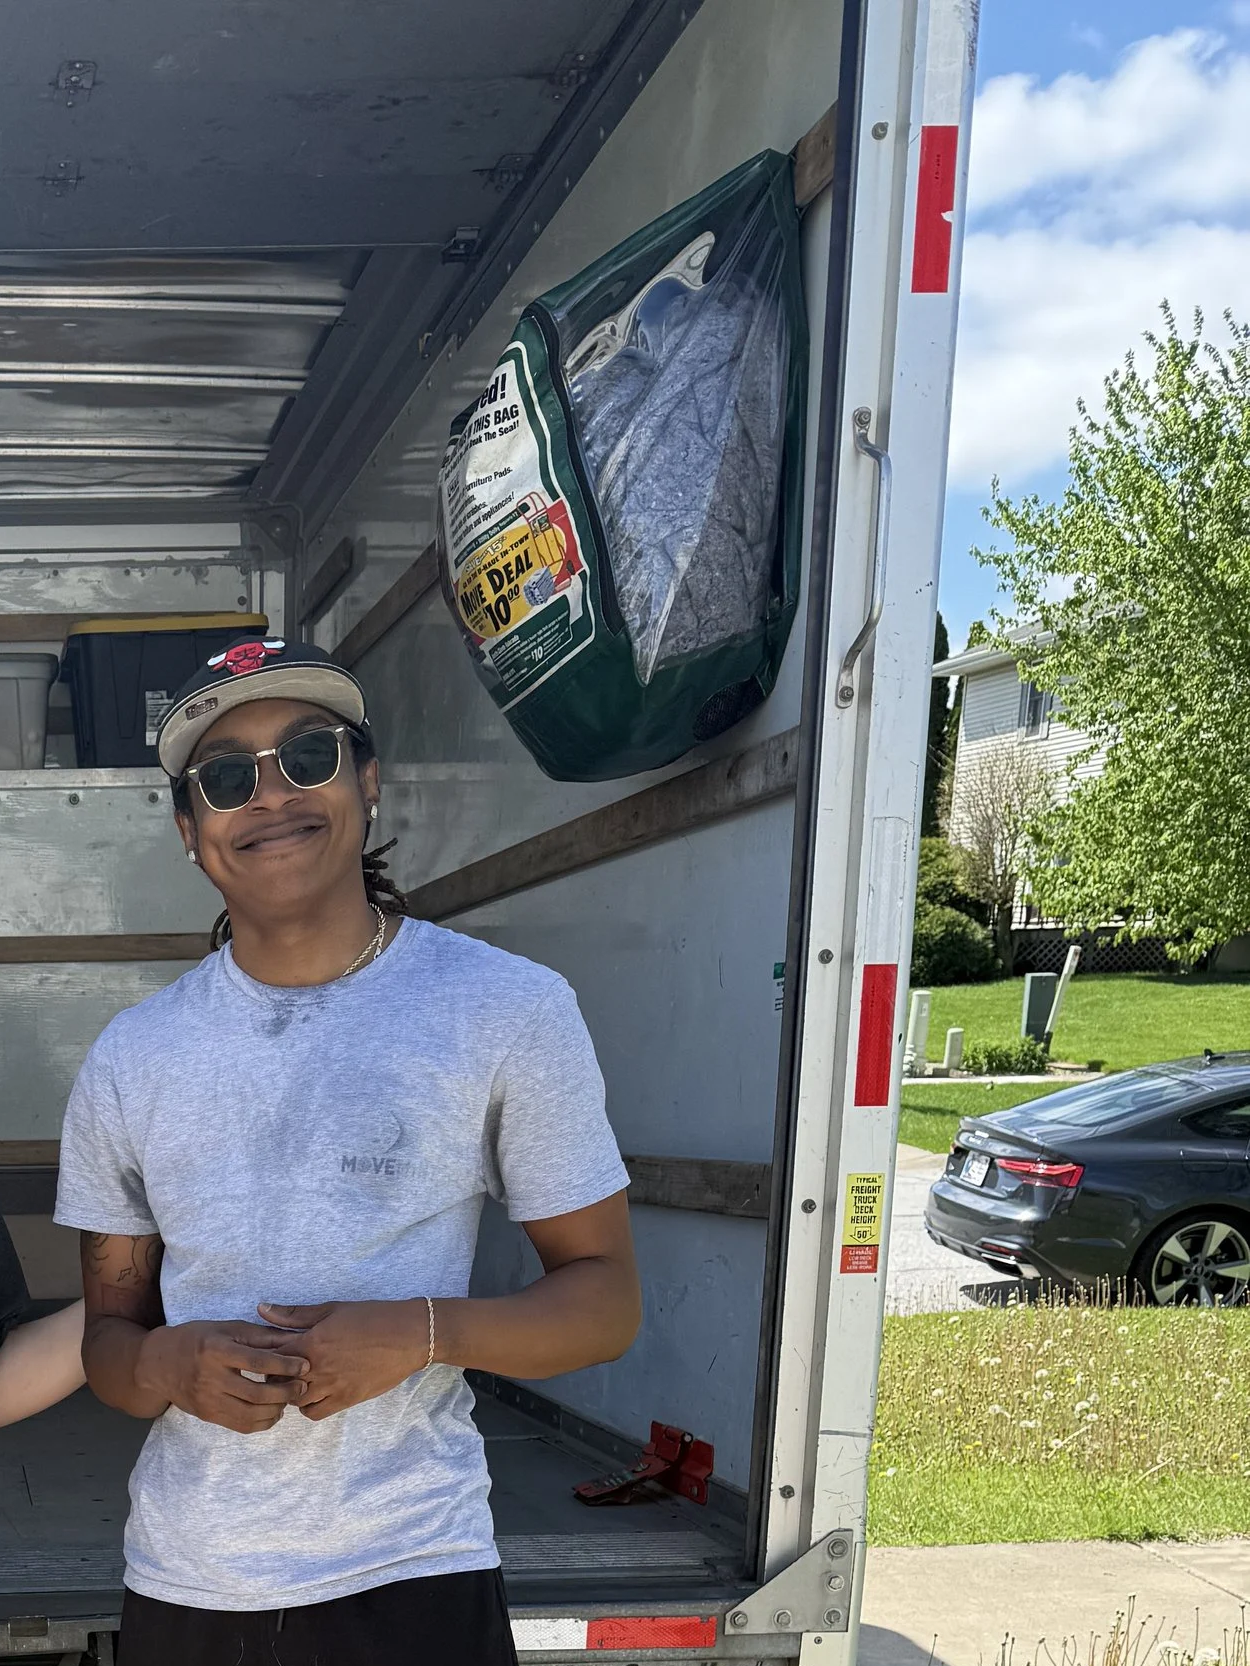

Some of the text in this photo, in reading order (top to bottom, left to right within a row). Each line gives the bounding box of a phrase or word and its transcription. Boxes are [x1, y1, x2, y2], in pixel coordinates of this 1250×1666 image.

[472, 403, 520, 436] THIS BAG
[498, 420, 520, 437] Seal!
[493, 466, 513, 481] Pads.
[481, 491, 515, 522] appliances!
[500, 532, 530, 559] IN-TOWN
[460, 546, 534, 619] MOVE DEAL
[850, 1185, 882, 1195] FREIGHT
[854, 1195, 878, 1205] TRUCK
[854, 1205, 875, 1215] DECK
[850, 1215, 878, 1224] HEIGHT
